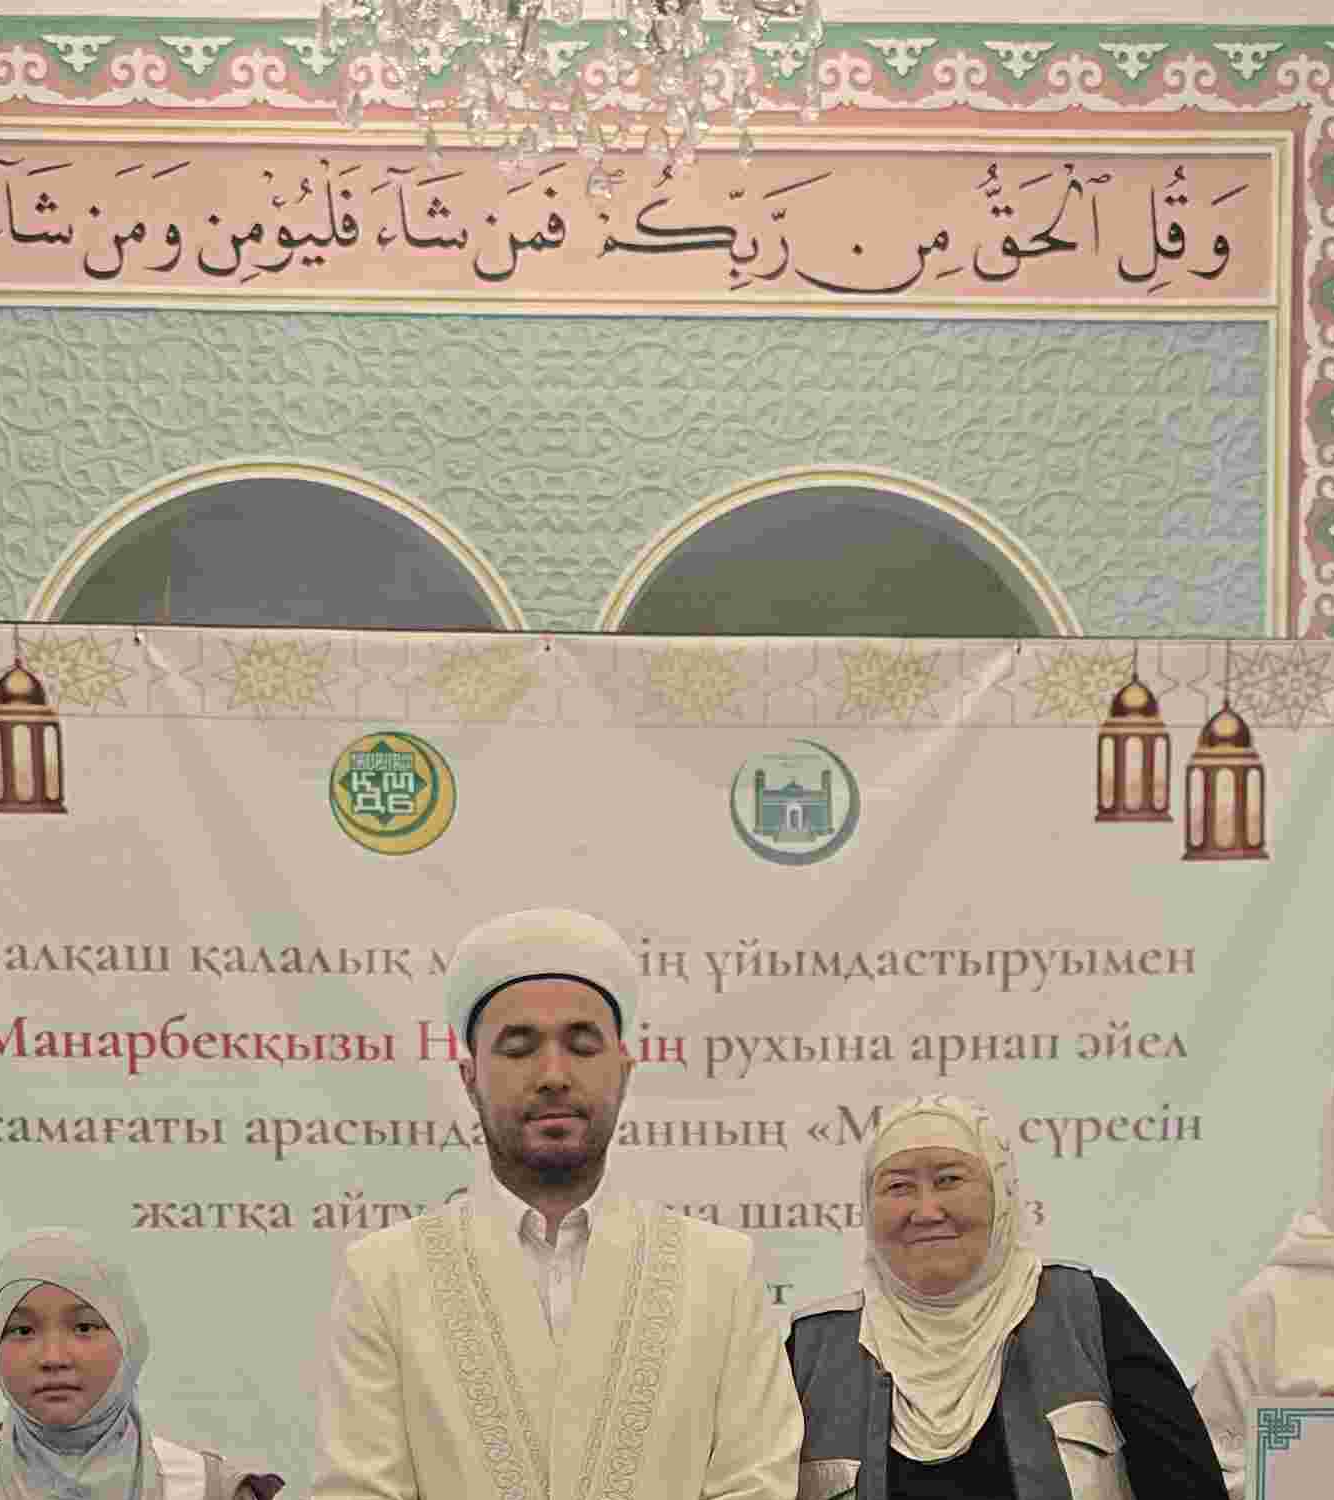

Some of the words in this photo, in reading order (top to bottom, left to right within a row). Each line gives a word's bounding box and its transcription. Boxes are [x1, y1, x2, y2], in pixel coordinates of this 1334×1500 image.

[188, 943, 413, 981] қалалық
[703, 938, 1197, 995] ұйымдастыруымен
[705, 1033, 893, 1080] рухына
[912, 1033, 1060, 1080] арнап
[1075, 1024, 1189, 1062] әйел
[245, 1110, 487, 1161] арасында
[1018, 1107, 1203, 1160] сүресін
[130, 1200, 293, 1236] жатқа
